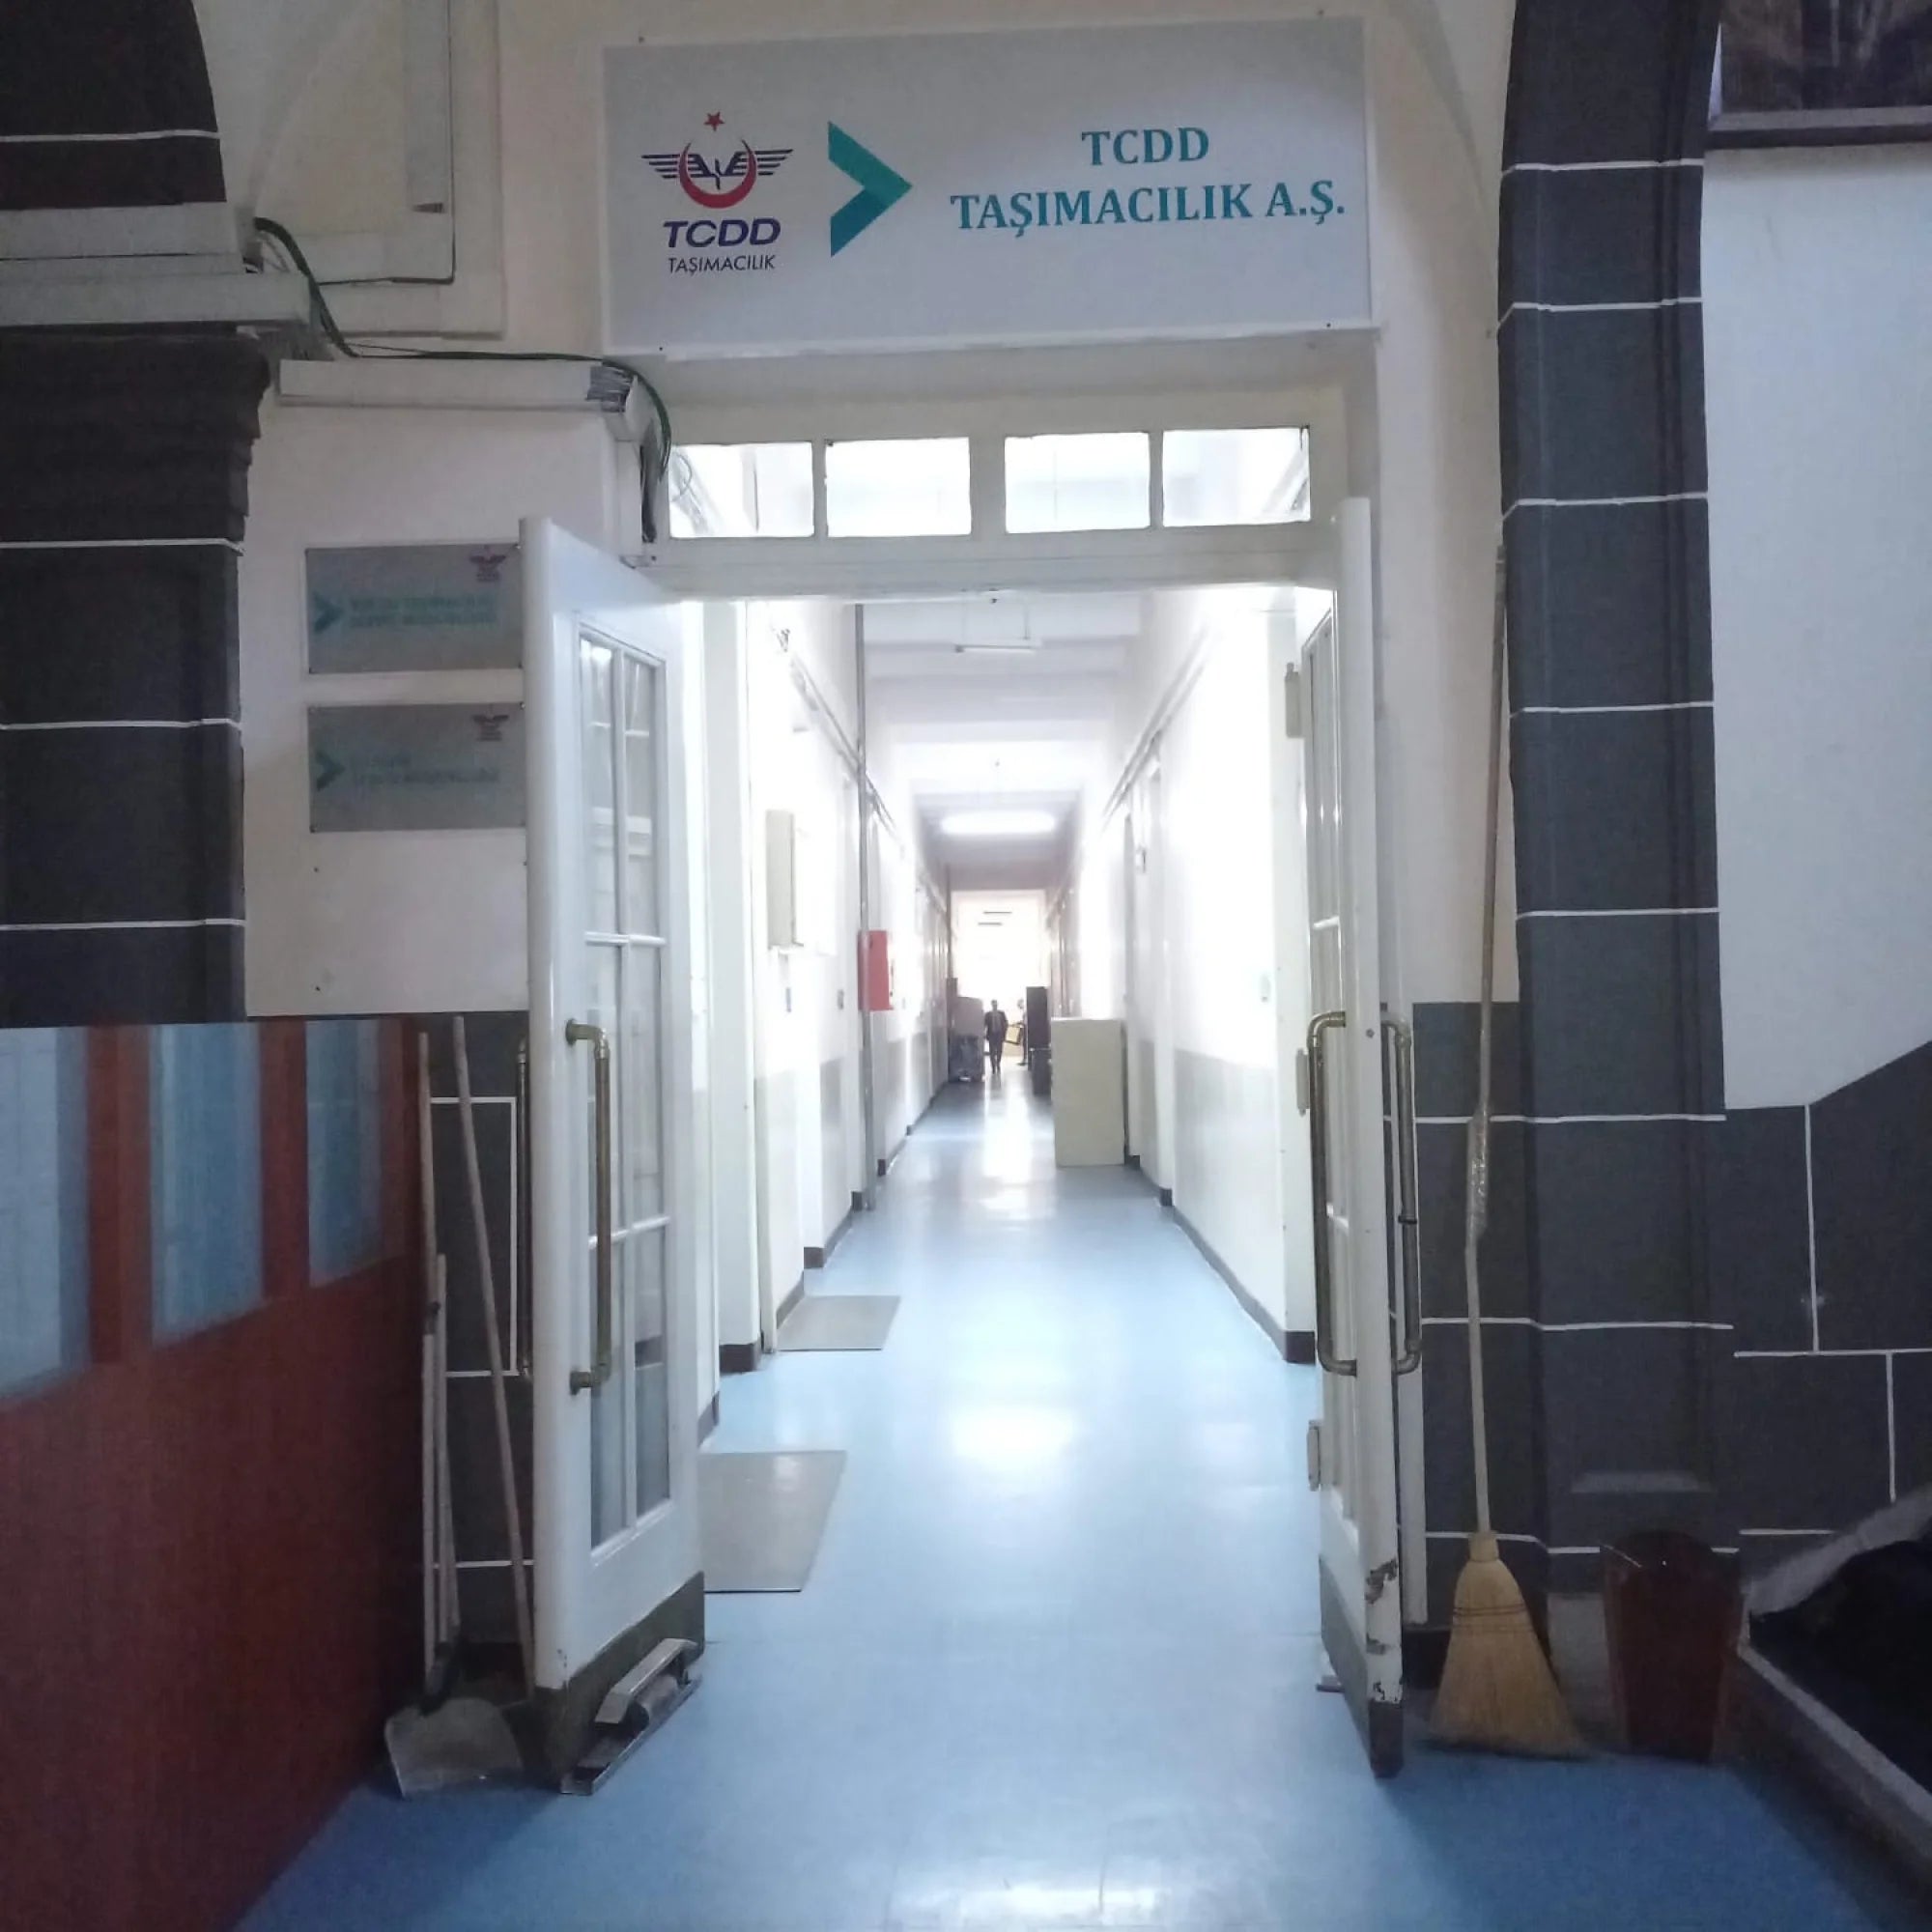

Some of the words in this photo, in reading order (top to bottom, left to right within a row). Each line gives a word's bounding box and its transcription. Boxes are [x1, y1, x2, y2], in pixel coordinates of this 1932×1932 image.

[1081, 127, 1209, 166] TCDD
[950, 183, 1253, 238] TAŞIMACILIK
[1264, 180, 1345, 225] A.Ş.
[663, 216, 781, 248] TCDD
[668, 254, 776, 277] TAŞIMACILIK
